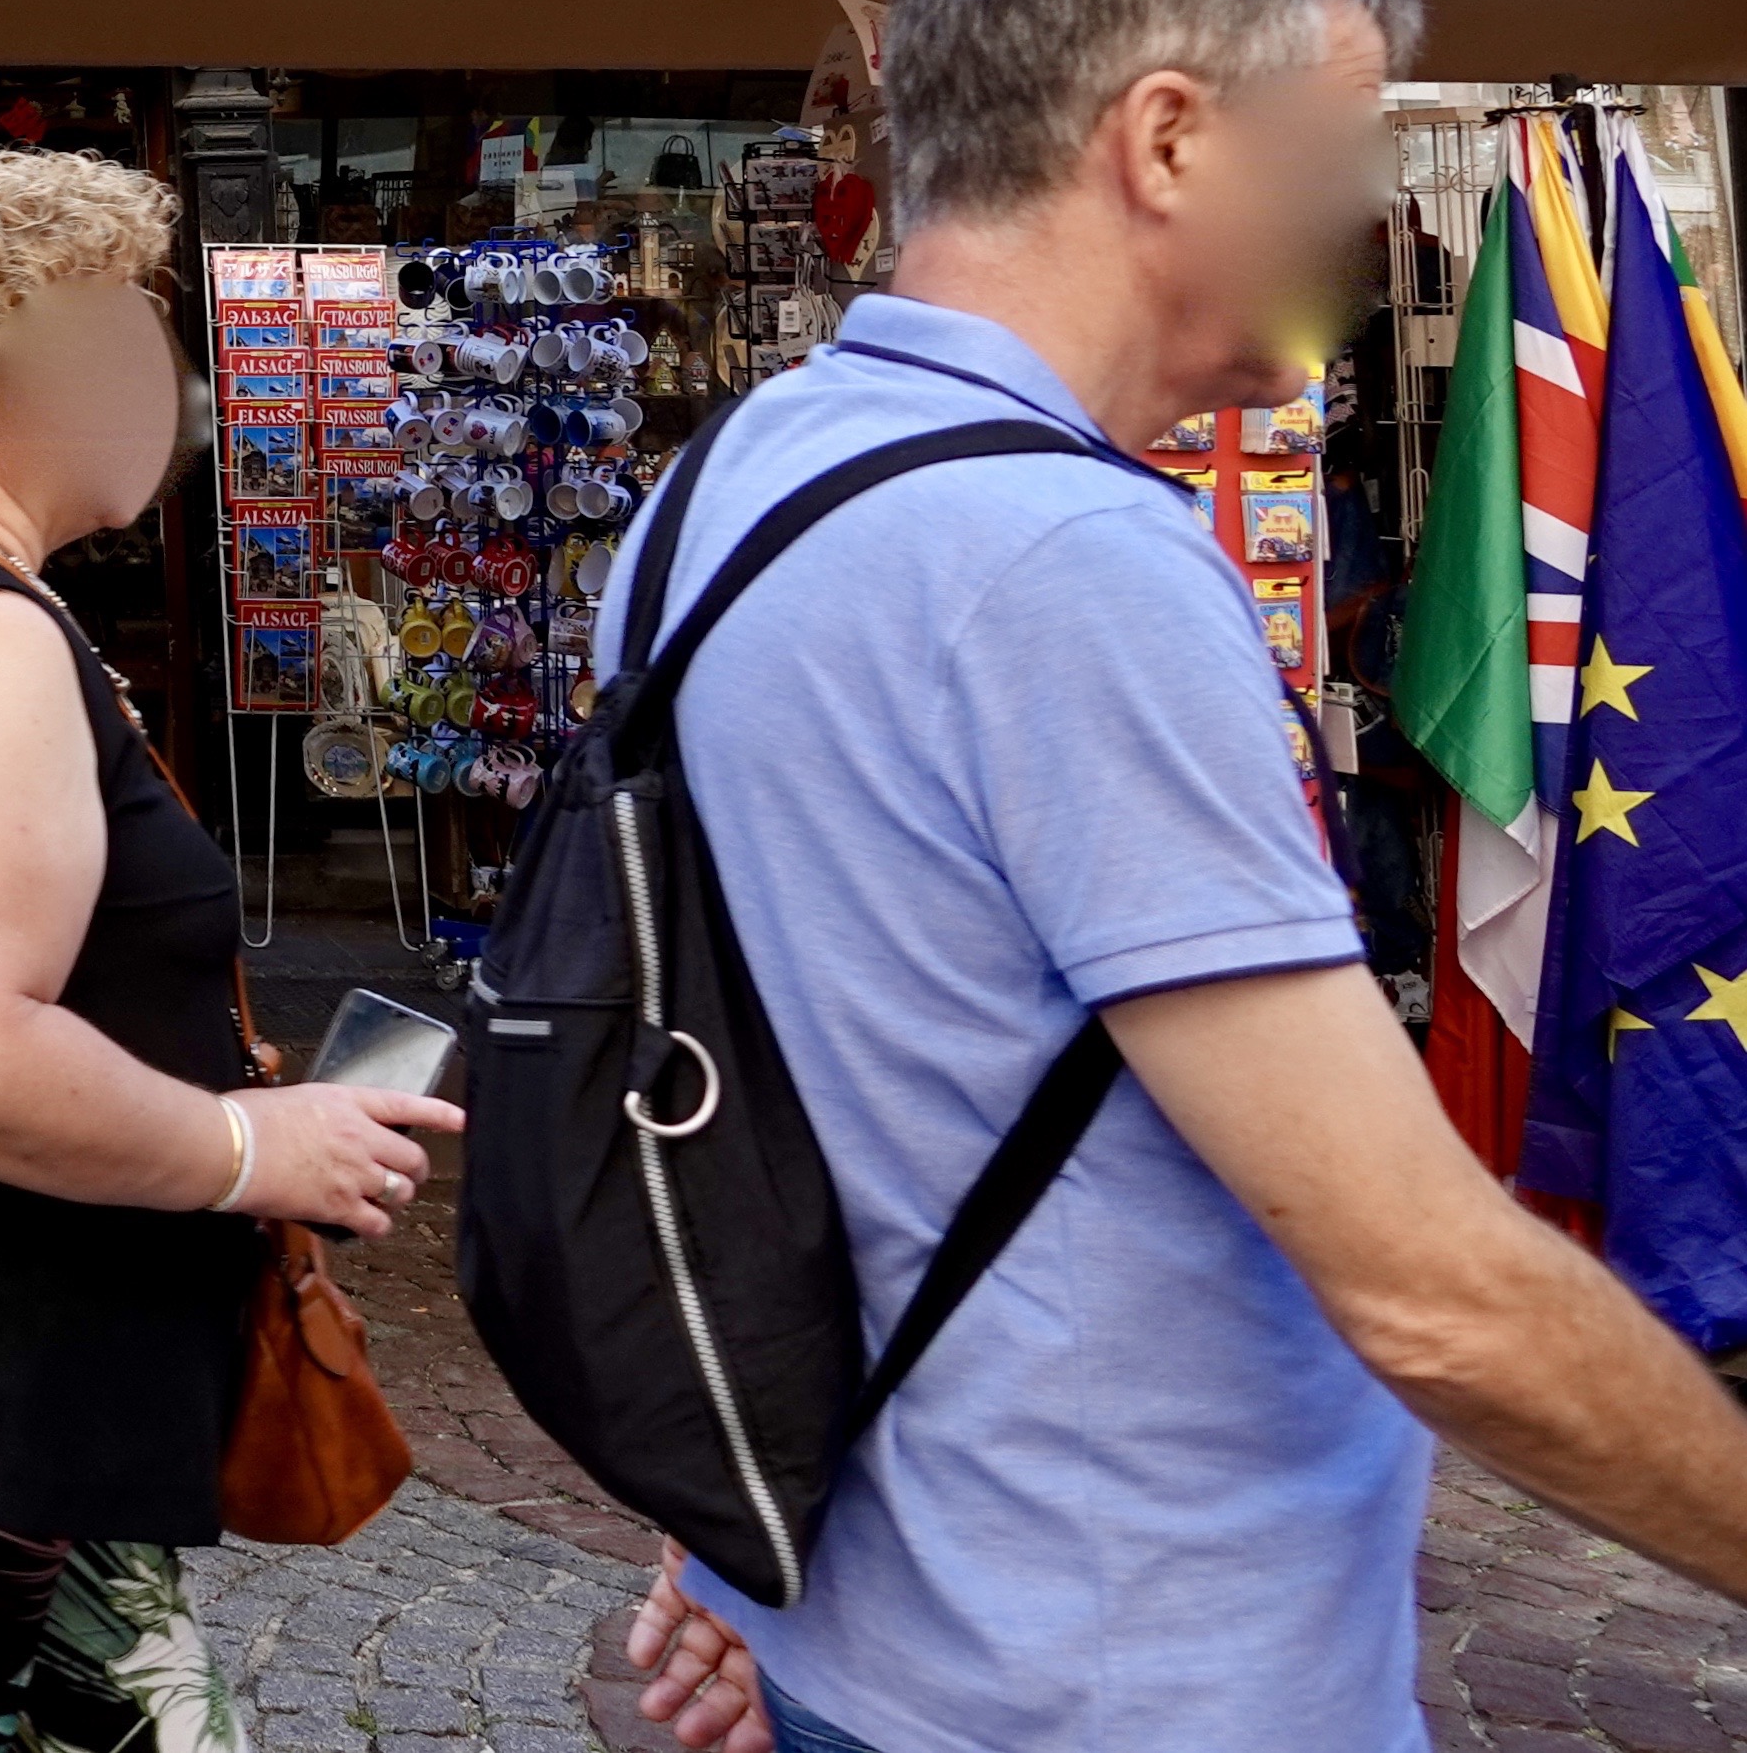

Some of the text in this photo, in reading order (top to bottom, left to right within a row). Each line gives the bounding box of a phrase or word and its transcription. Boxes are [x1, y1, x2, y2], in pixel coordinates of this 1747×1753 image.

[223, 262, 291, 278] アルザス
[309, 264, 378, 280] STRASBURGO
[228, 310, 295, 324] ЭЛЬЗАС
[238, 359, 296, 374] ALSACE
[238, 408, 297, 424] ELSASS
[326, 459, 398, 476] ESTRASBURGO
[243, 509, 306, 526] ALSAZIA
[251, 611, 309, 627] ALSACE
